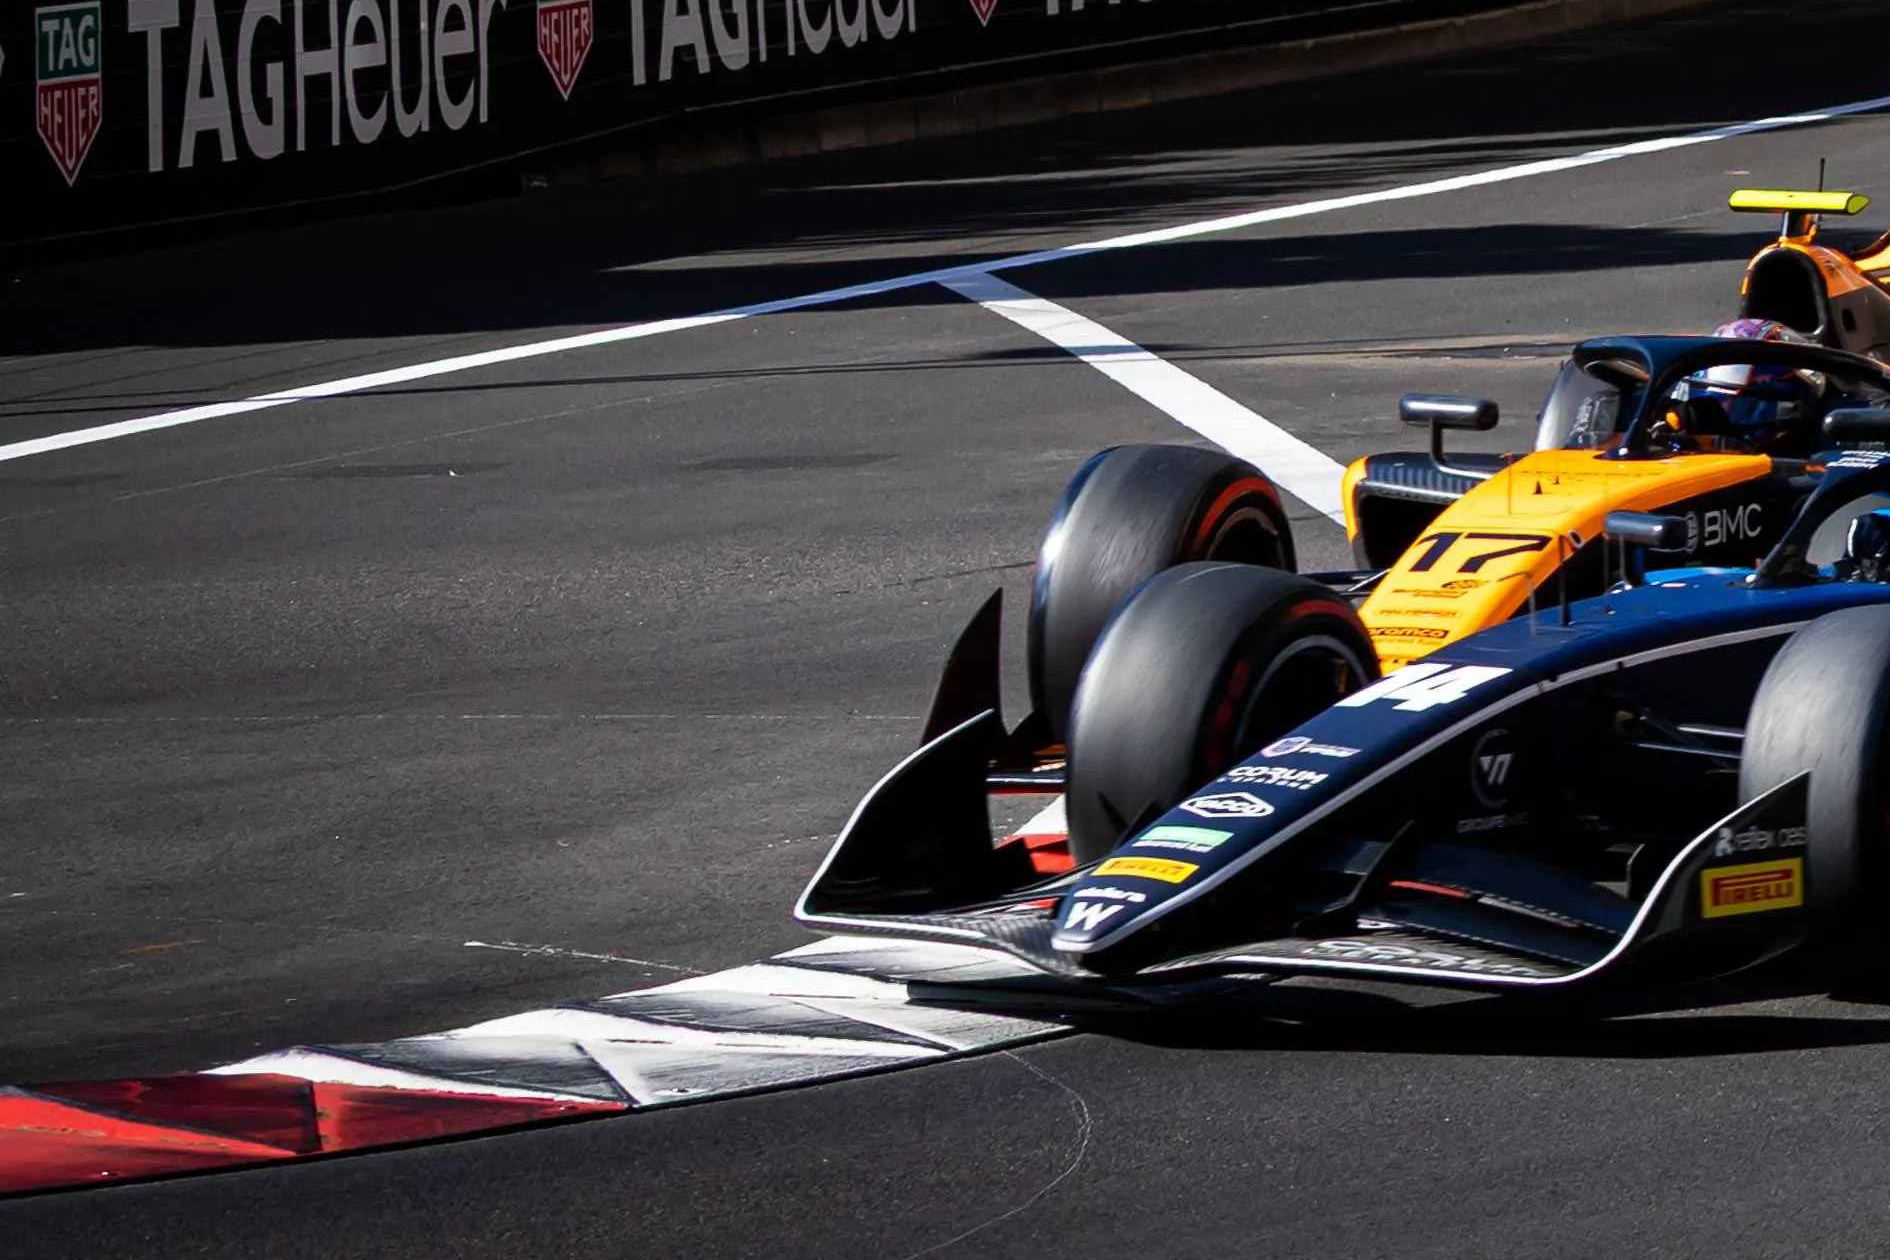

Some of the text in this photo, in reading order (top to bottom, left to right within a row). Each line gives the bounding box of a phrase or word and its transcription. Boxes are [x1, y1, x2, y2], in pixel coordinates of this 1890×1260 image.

[42, 14, 95, 71] TAG
[539, 5, 591, 86] HEUER
[39, 86, 101, 174] HEUER
[1703, 502, 1763, 547] BMC
[1409, 532, 1553, 573] 17
[1334, 662, 1515, 712] 14
[1228, 765, 1329, 785] CORUM
[1711, 869, 1793, 907] PIRELLI
